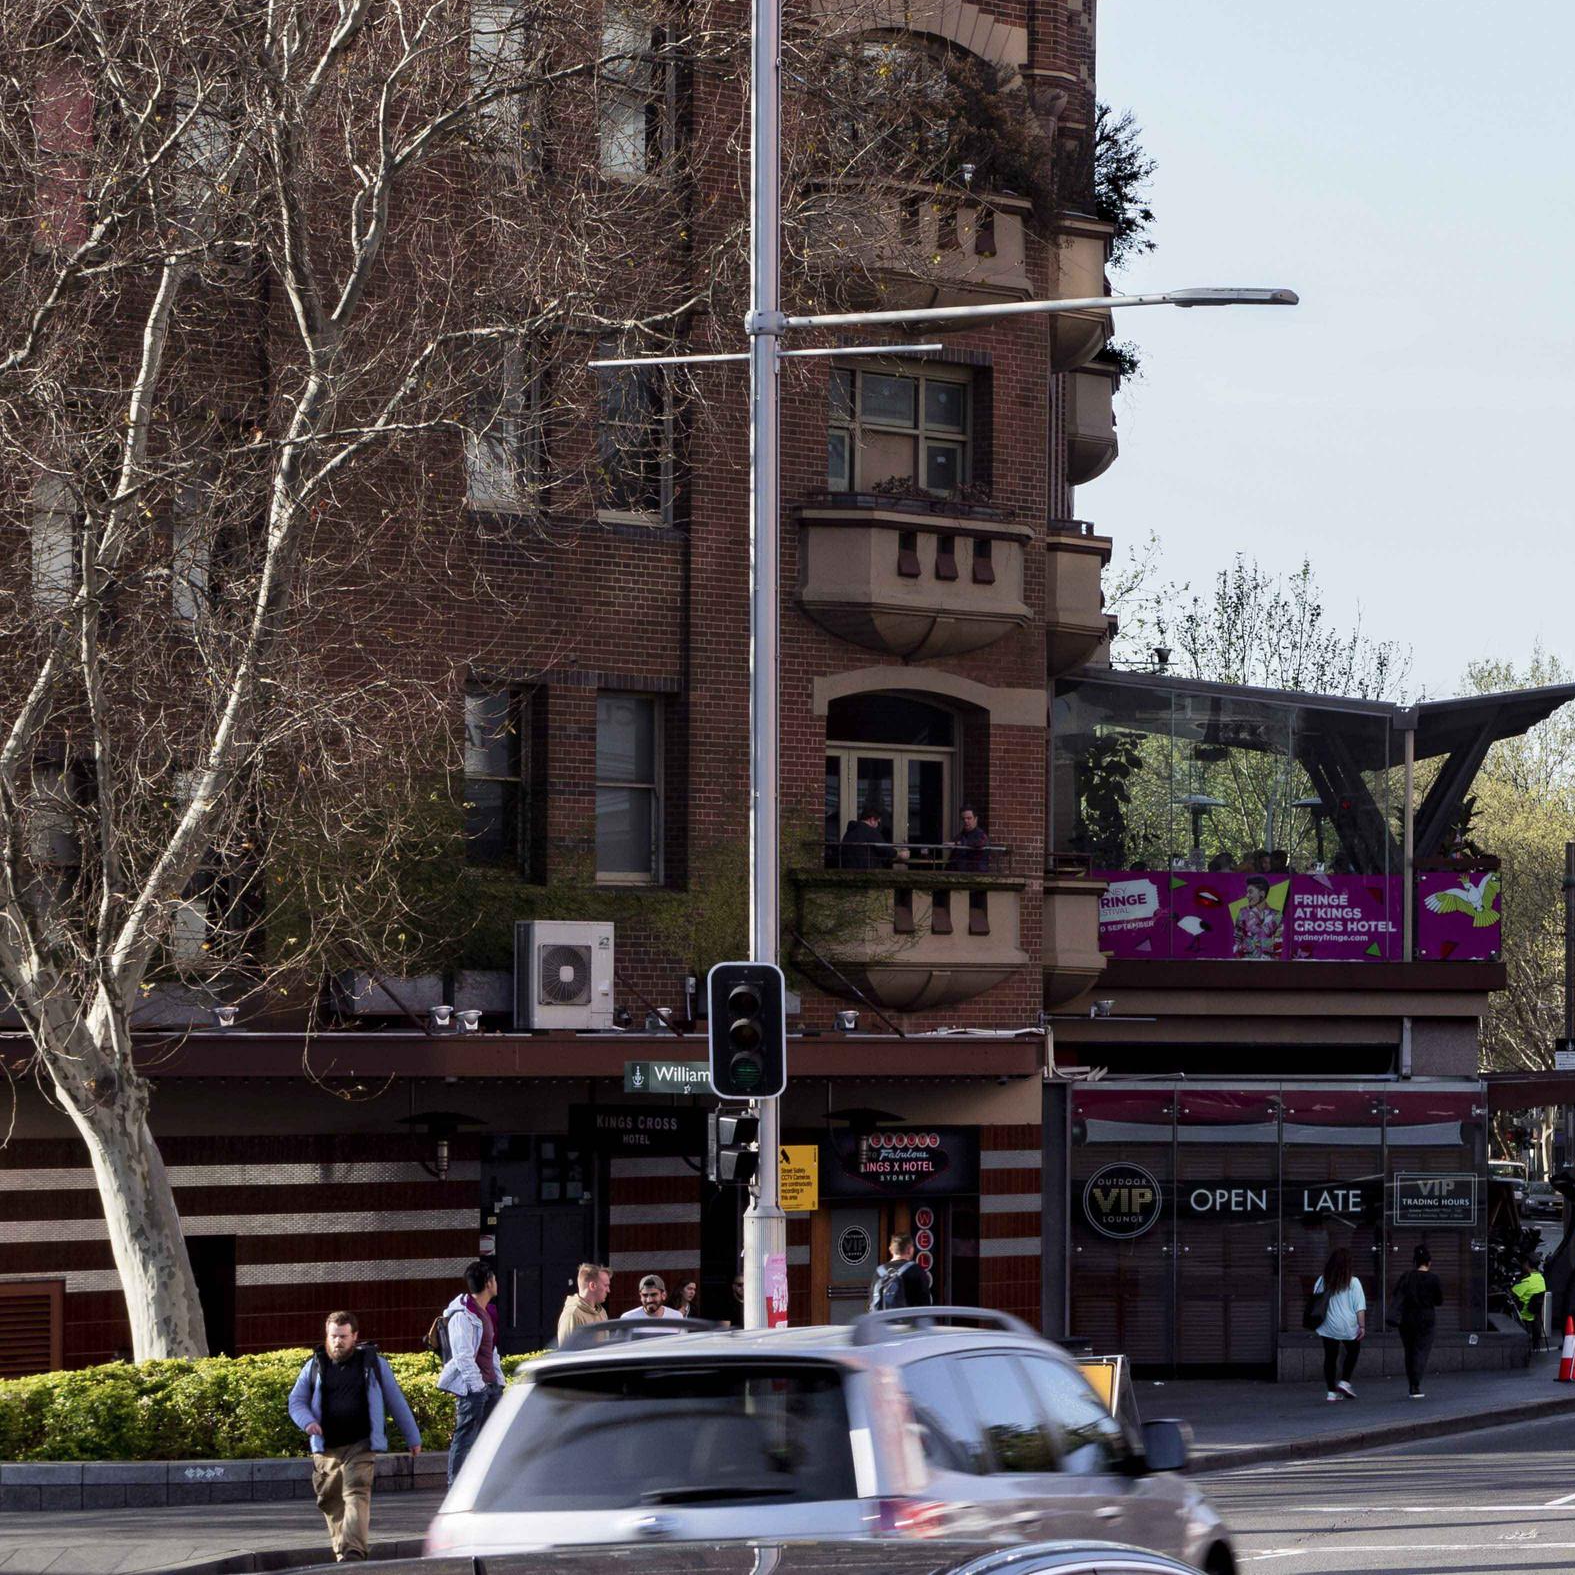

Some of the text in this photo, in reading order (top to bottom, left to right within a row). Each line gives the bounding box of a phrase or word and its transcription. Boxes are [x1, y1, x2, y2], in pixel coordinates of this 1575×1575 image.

[1101, 892, 1147, 909] RINGE
[1294, 894, 1348, 906] FRINGE
[1294, 907, 1362, 918] AT KINGS
[1108, 920, 1154, 932] SEPTEMBER
[1294, 920, 1397, 932] CROSS HOTEL
[1294, 933, 1368, 942] sydneyfringe.com
[654, 1065, 711, 1082] William
[597, 1114, 678, 1130] KINGS CROSS
[623, 1134, 650, 1144] HOTEL
[865, 1161, 935, 1172] INGS X HOTEL
[880, 1174, 916, 1182] SYDNEY
[1097, 1177, 1148, 1186] OUTDOOR
[1417, 1180, 1455, 1196] VIP
[1092, 1188, 1153, 1213] VIP
[1190, 1189, 1267, 1212] OPEN
[1303, 1190, 1362, 1212] LATE
[1402, 1197, 1470, 1206] TRADING HOURS
[1102, 1215, 1143, 1223] LOUNGE
[844, 1238, 867, 1251] VIP
